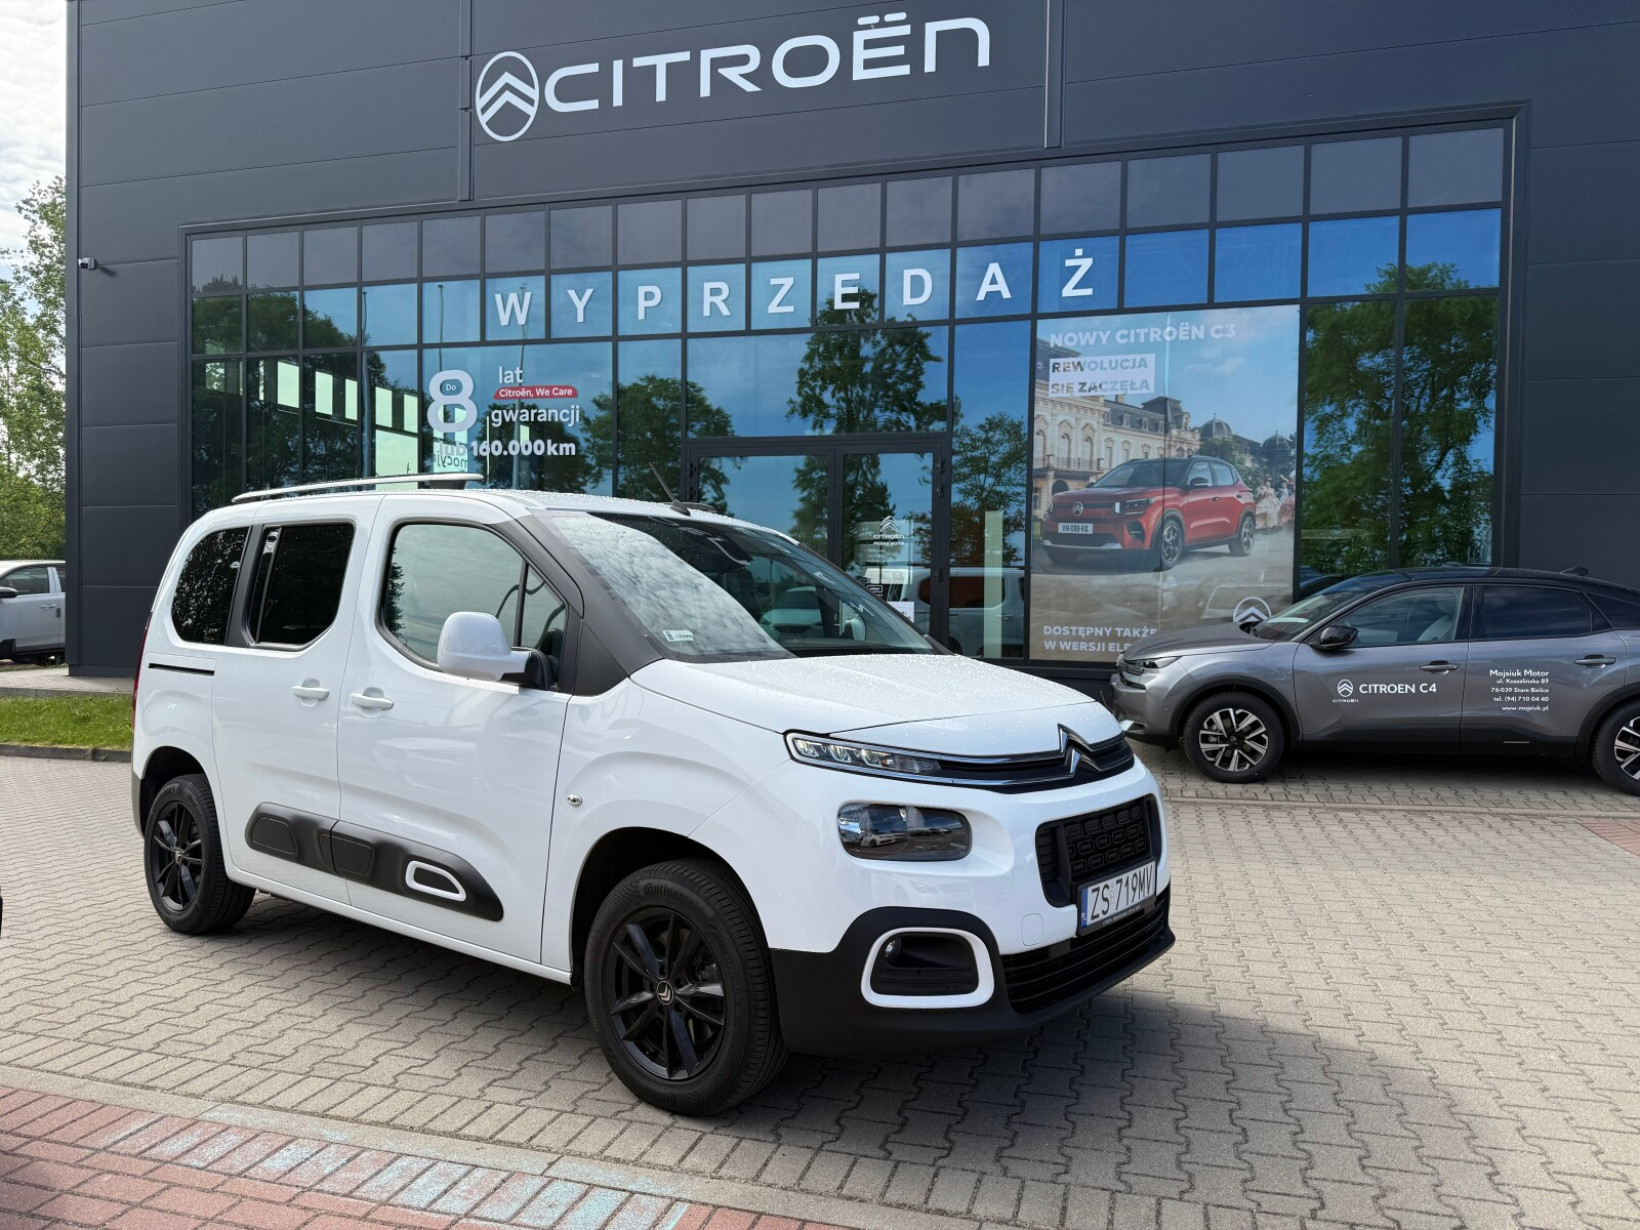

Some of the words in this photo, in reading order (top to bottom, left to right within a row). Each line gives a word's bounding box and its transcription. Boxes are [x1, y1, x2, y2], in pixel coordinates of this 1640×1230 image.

[1049, 330, 1111, 347] NOWY
[1115, 322, 1205, 343] CITROËN
[1210, 324, 1236, 339] C3
[1051, 357, 1149, 373] REWOLUCJA
[498, 366, 524, 384] lat
[445, 383, 457, 391] Do
[499, 388, 534, 398] Citroën,
[535, 388, 550, 397] We
[552, 387, 573, 396] Care
[1077, 378, 1150, 396] ZACZĘŁA
[427, 369, 478, 433] 8
[491, 404, 580, 428] gwarancji
[440, 441, 467, 457] lub
[1043, 625, 1112, 639] DOSTĘPNY
[1044, 640, 1056, 651] W
[1059, 641, 1106, 652] WERSJI
[1490, 669, 1522, 679] Mojsiuk
[1523, 669, 1549, 677] Motor
[1419, 683, 1437, 693] C4
[1090, 884, 1110, 921] ZS
[1115, 864, 1153, 911] 719MV
